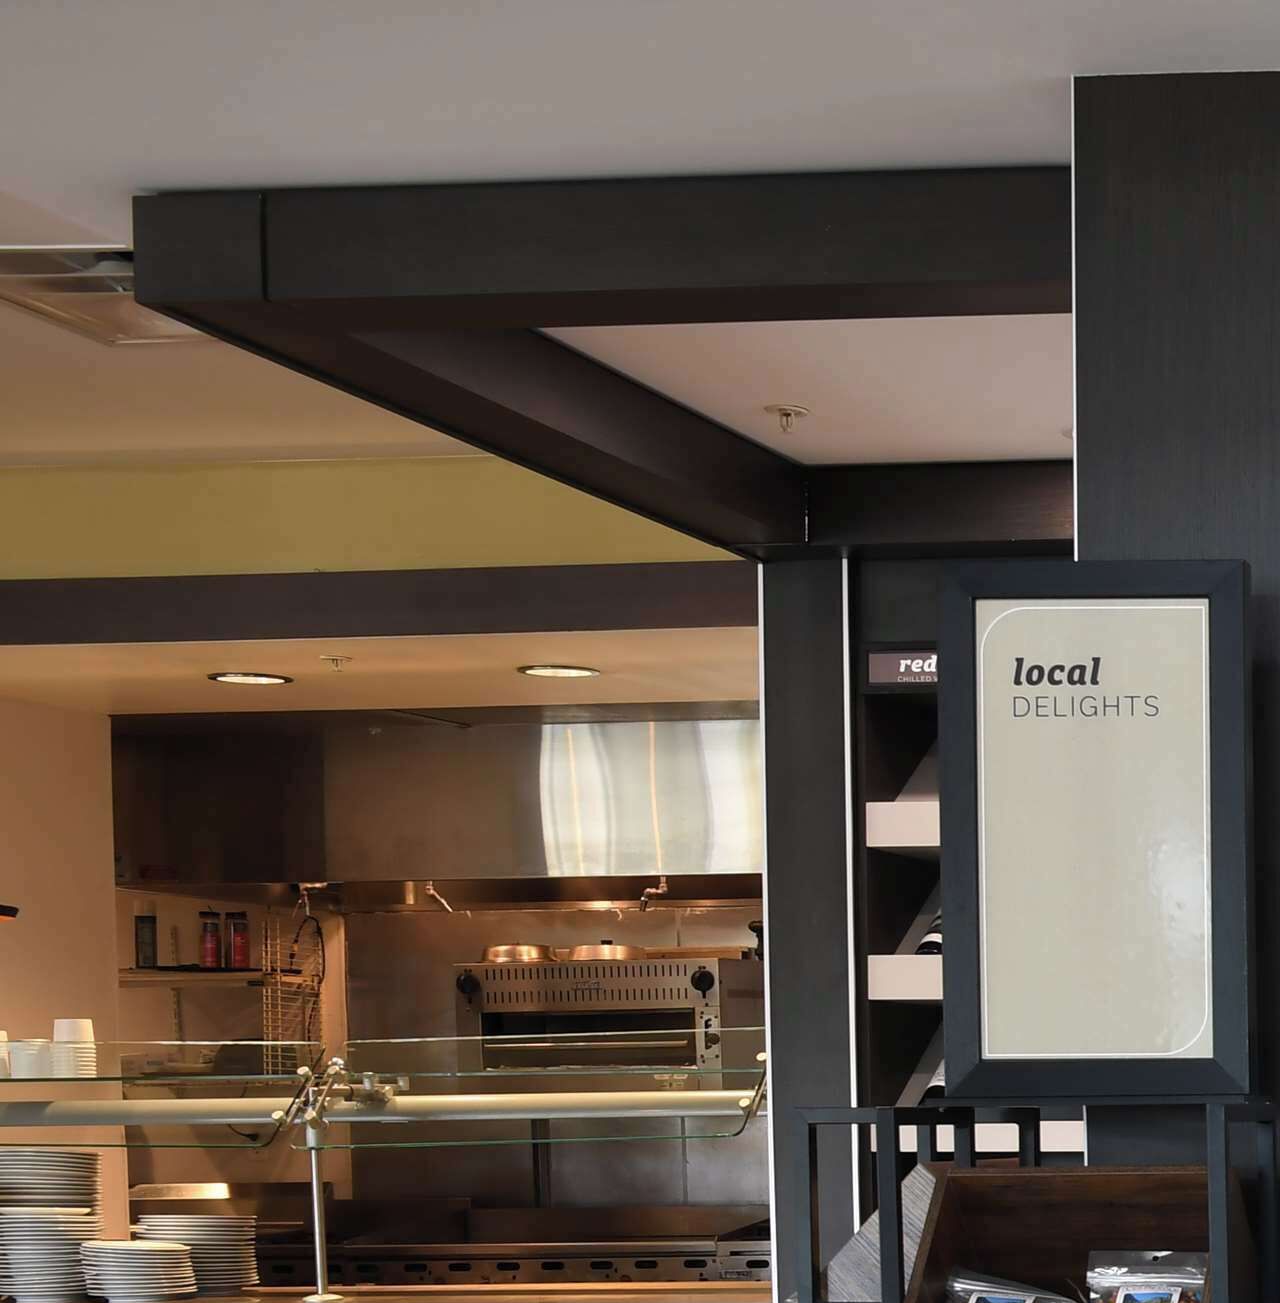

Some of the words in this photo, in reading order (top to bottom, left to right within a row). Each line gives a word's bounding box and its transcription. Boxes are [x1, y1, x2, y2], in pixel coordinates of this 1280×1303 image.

[900, 654, 938, 672] red
[1013, 657, 1101, 686] local
[897, 675, 932, 683] CHILLED
[1013, 695, 1160, 718] DELIGHTS
